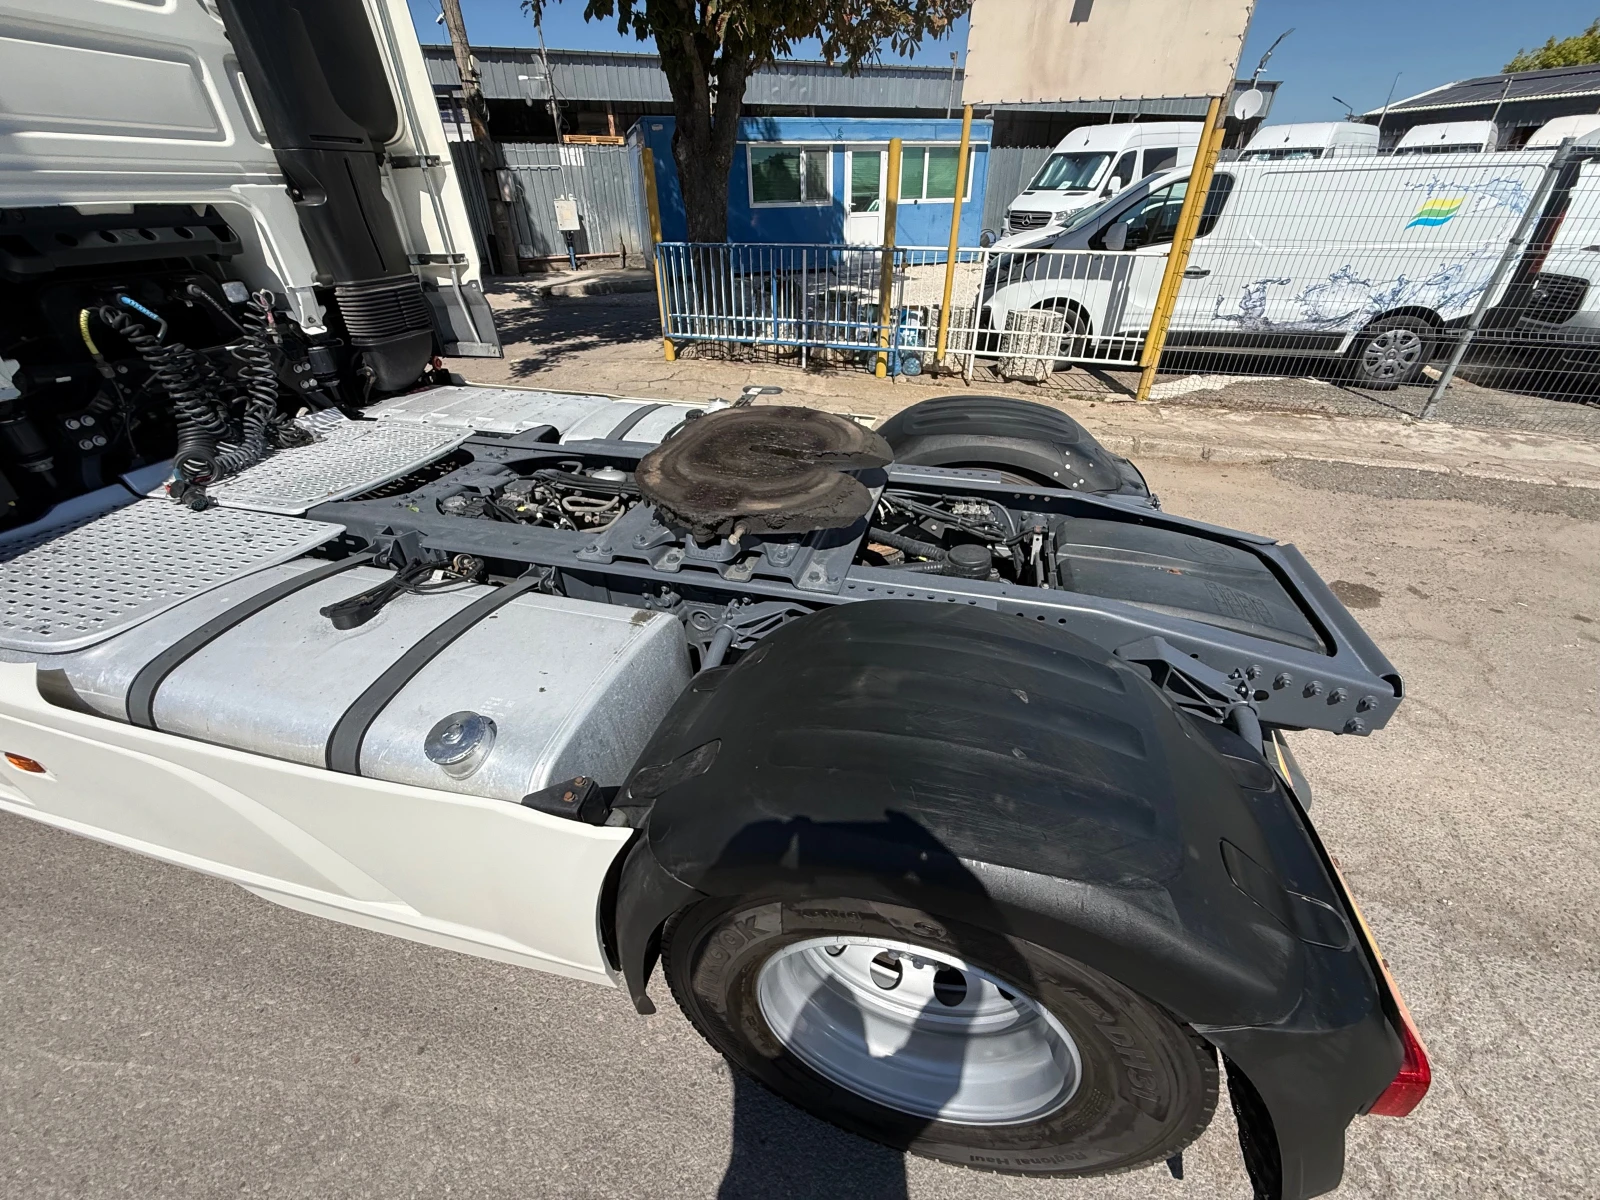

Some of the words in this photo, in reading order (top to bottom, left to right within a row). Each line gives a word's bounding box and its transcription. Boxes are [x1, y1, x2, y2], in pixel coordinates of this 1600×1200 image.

[697, 914, 771, 1018] NKOOK
[969, 1154, 1010, 1166] Haul
[1015, 1151, 1088, 1166] Regional
